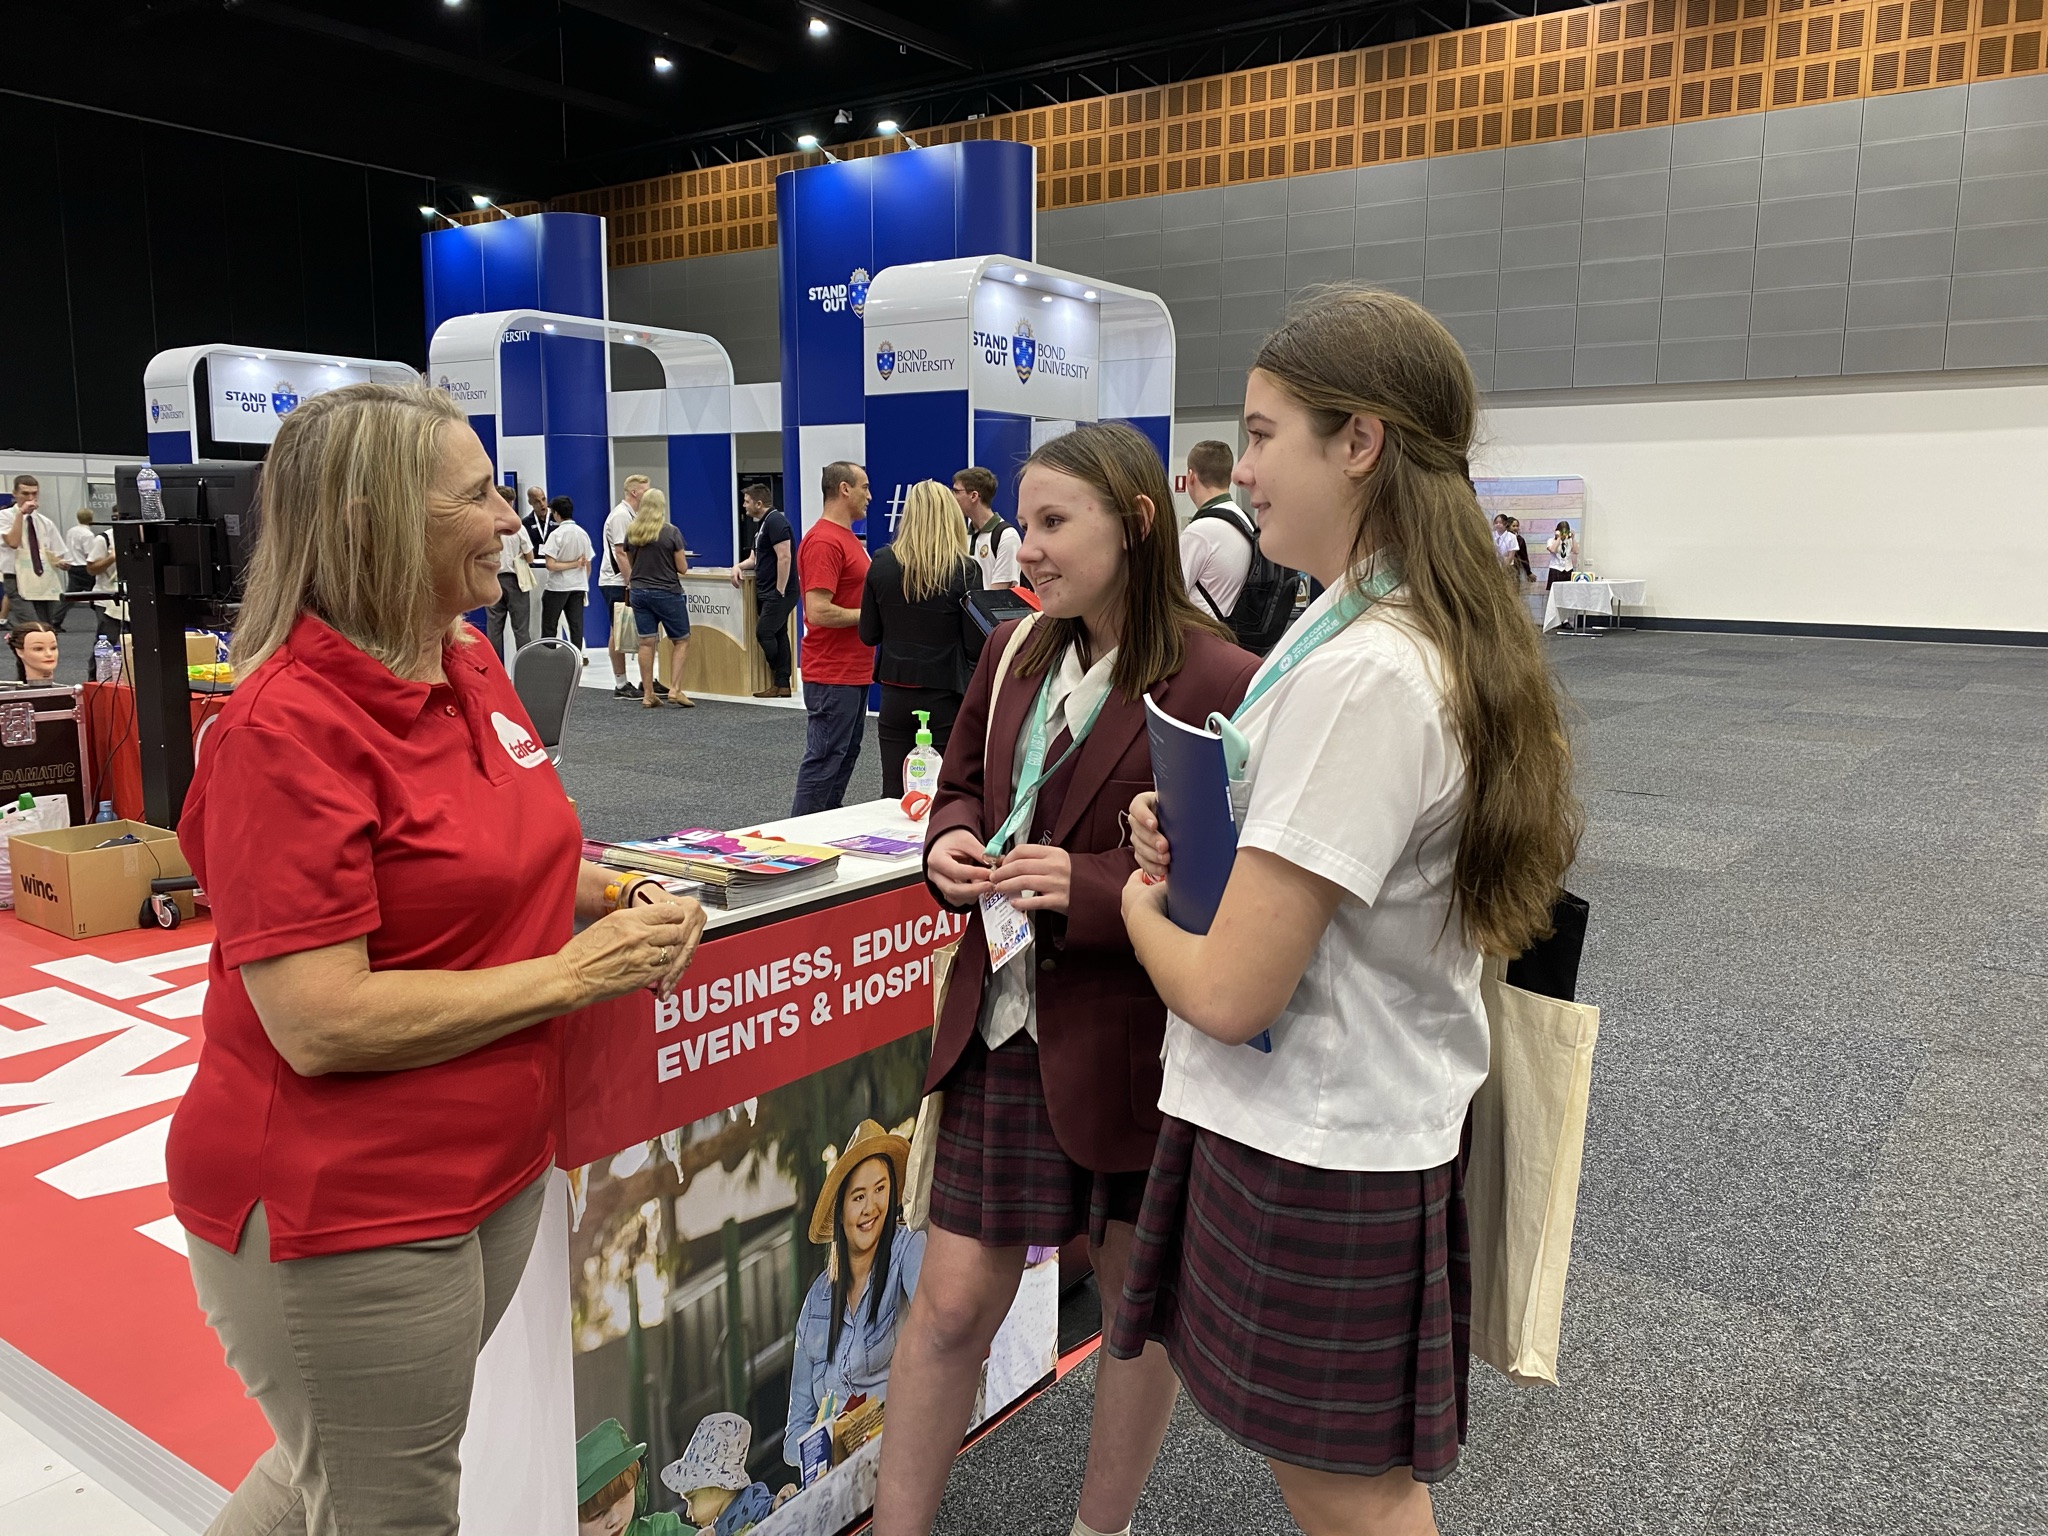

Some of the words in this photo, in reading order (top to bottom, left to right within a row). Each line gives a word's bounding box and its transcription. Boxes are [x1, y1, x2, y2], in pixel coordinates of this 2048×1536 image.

[808, 284, 848, 301] STAND
[822, 297, 848, 313] OUT
[501, 330, 531, 343] VERSITY
[973, 330, 1008, 351] STAND
[897, 349, 928, 362] BOND
[985, 350, 1008, 367] OUT
[1038, 343, 1066, 361] BOND
[897, 359, 955, 374] UNIVERSITY
[1038, 359, 1090, 380] UNIVERSITY
[451, 382, 470, 391] BOND
[225, 390, 266, 403] STAND
[451, 390, 487, 400] UNIVERSITY
[242, 402, 267, 413] OUT
[688, 594, 711, 604] BOND
[688, 604, 731, 615] UNIVERSITY
[1292, 636, 1309, 654] GOLD
[1309, 616, 1330, 638] COAST
[1293, 631, 1323, 660] STUDENT
[1322, 619, 1340, 635] HUB
[20, 873, 59, 903] winc.
[654, 945, 842, 1033] BUSINESS,
[852, 909, 971, 967] EDUCAT
[657, 1002, 800, 1083] EVENTS
[810, 991, 833, 1026] &
[842, 953, 935, 1015] HOSPI
